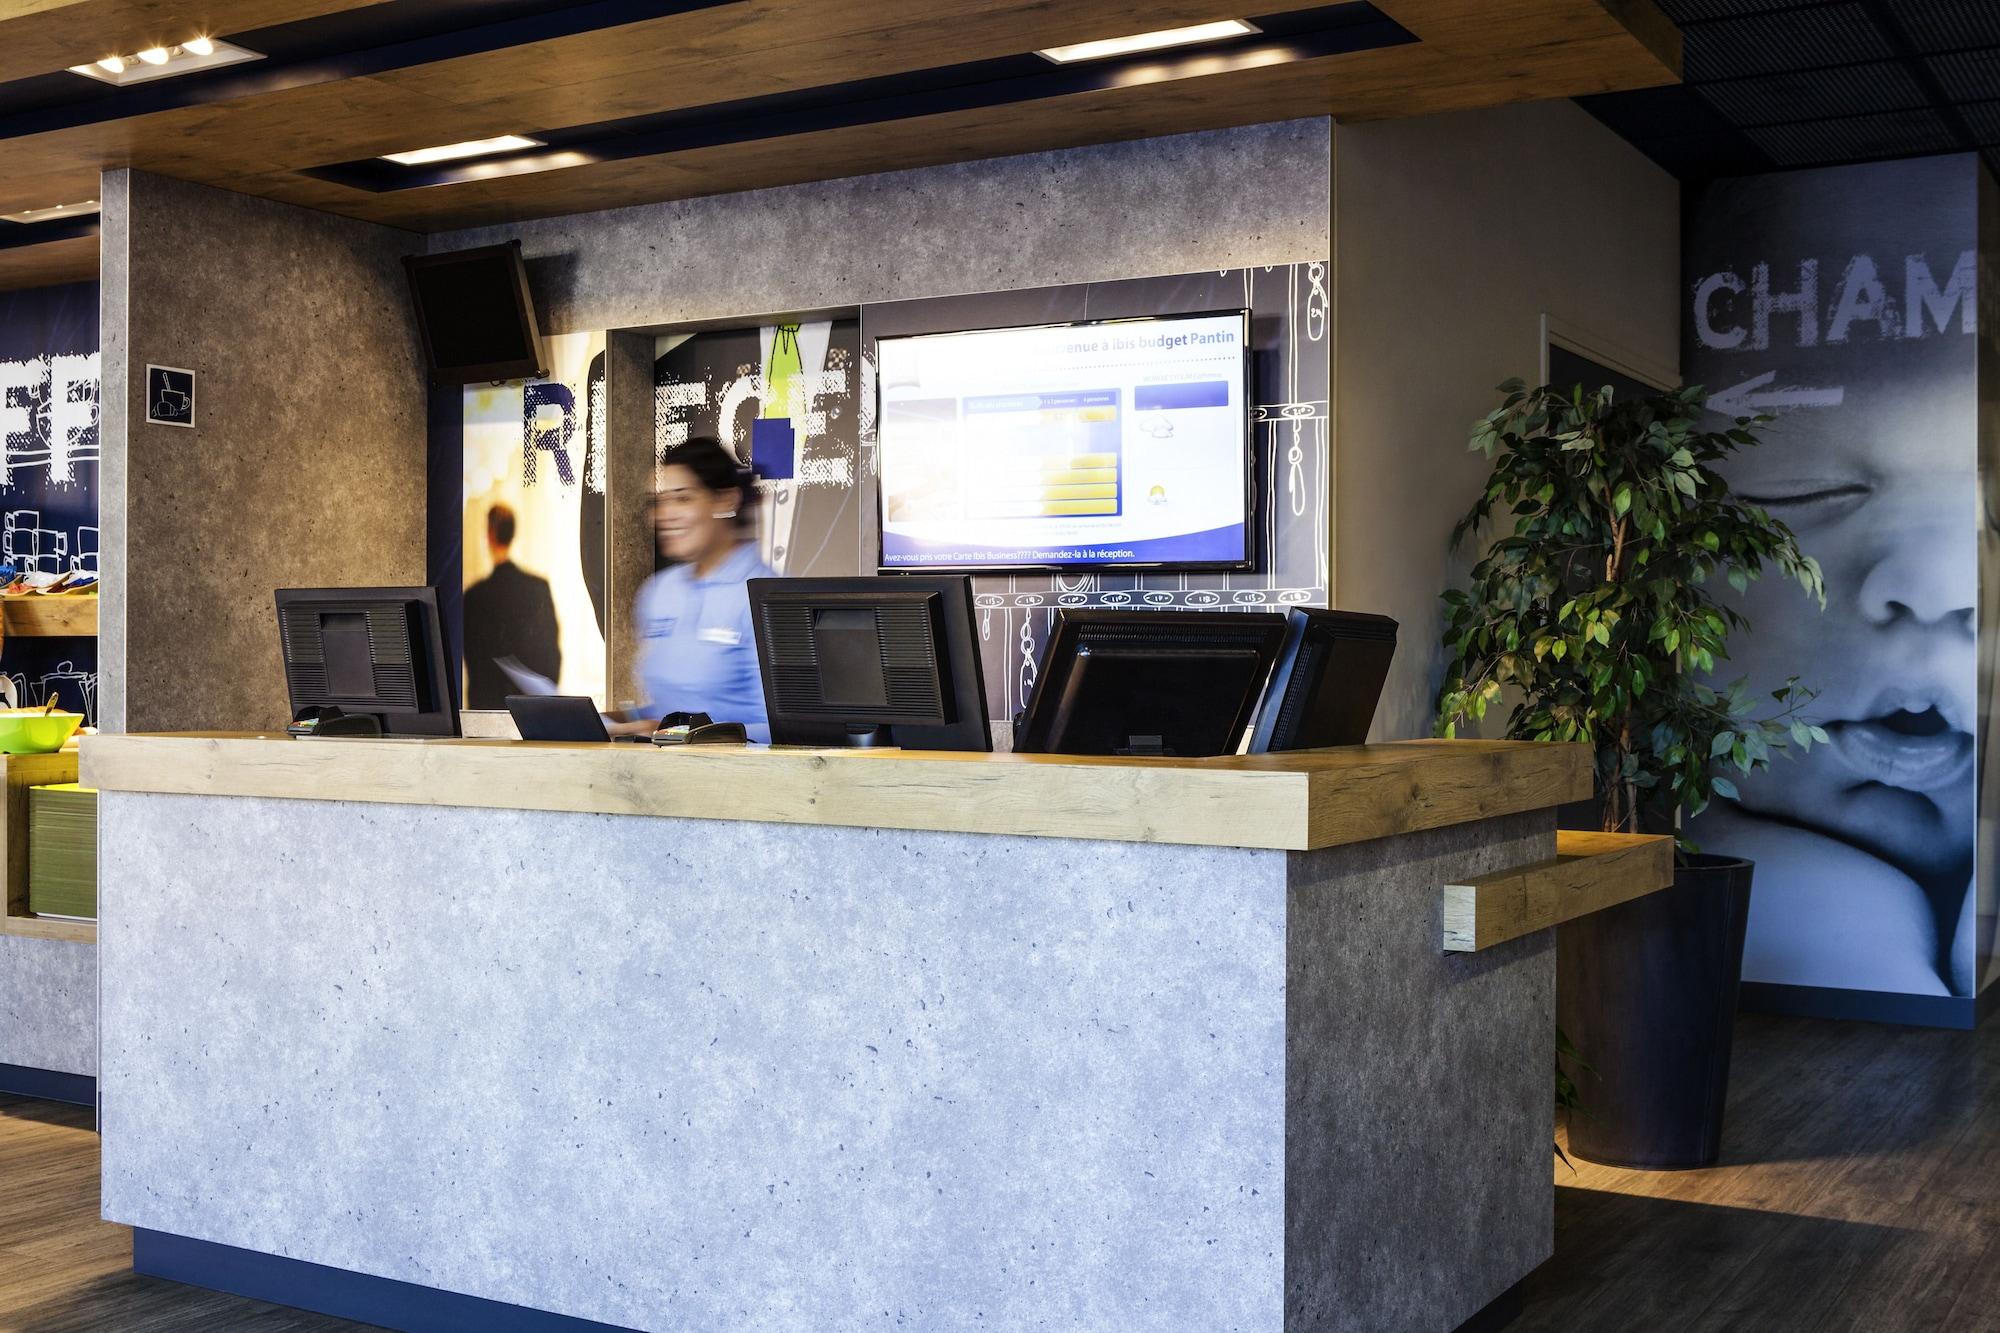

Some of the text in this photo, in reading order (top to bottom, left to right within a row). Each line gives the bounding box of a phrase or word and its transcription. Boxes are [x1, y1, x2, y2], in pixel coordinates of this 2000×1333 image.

[1693, 249, 1978, 351] CHAM
[1138, 334, 1188, 350] budget
[1190, 330, 1234, 345] Pantin
[884, 553, 919, 562] Avez-vous
[920, 552, 933, 563] pris
[953, 551, 972, 561] Carte
[1032, 549, 1081, 560] Demandez-la
[1082, 549, 1088, 559] à
[1088, 549, 1096, 559] la
[1097, 549, 1135, 560] réception.
